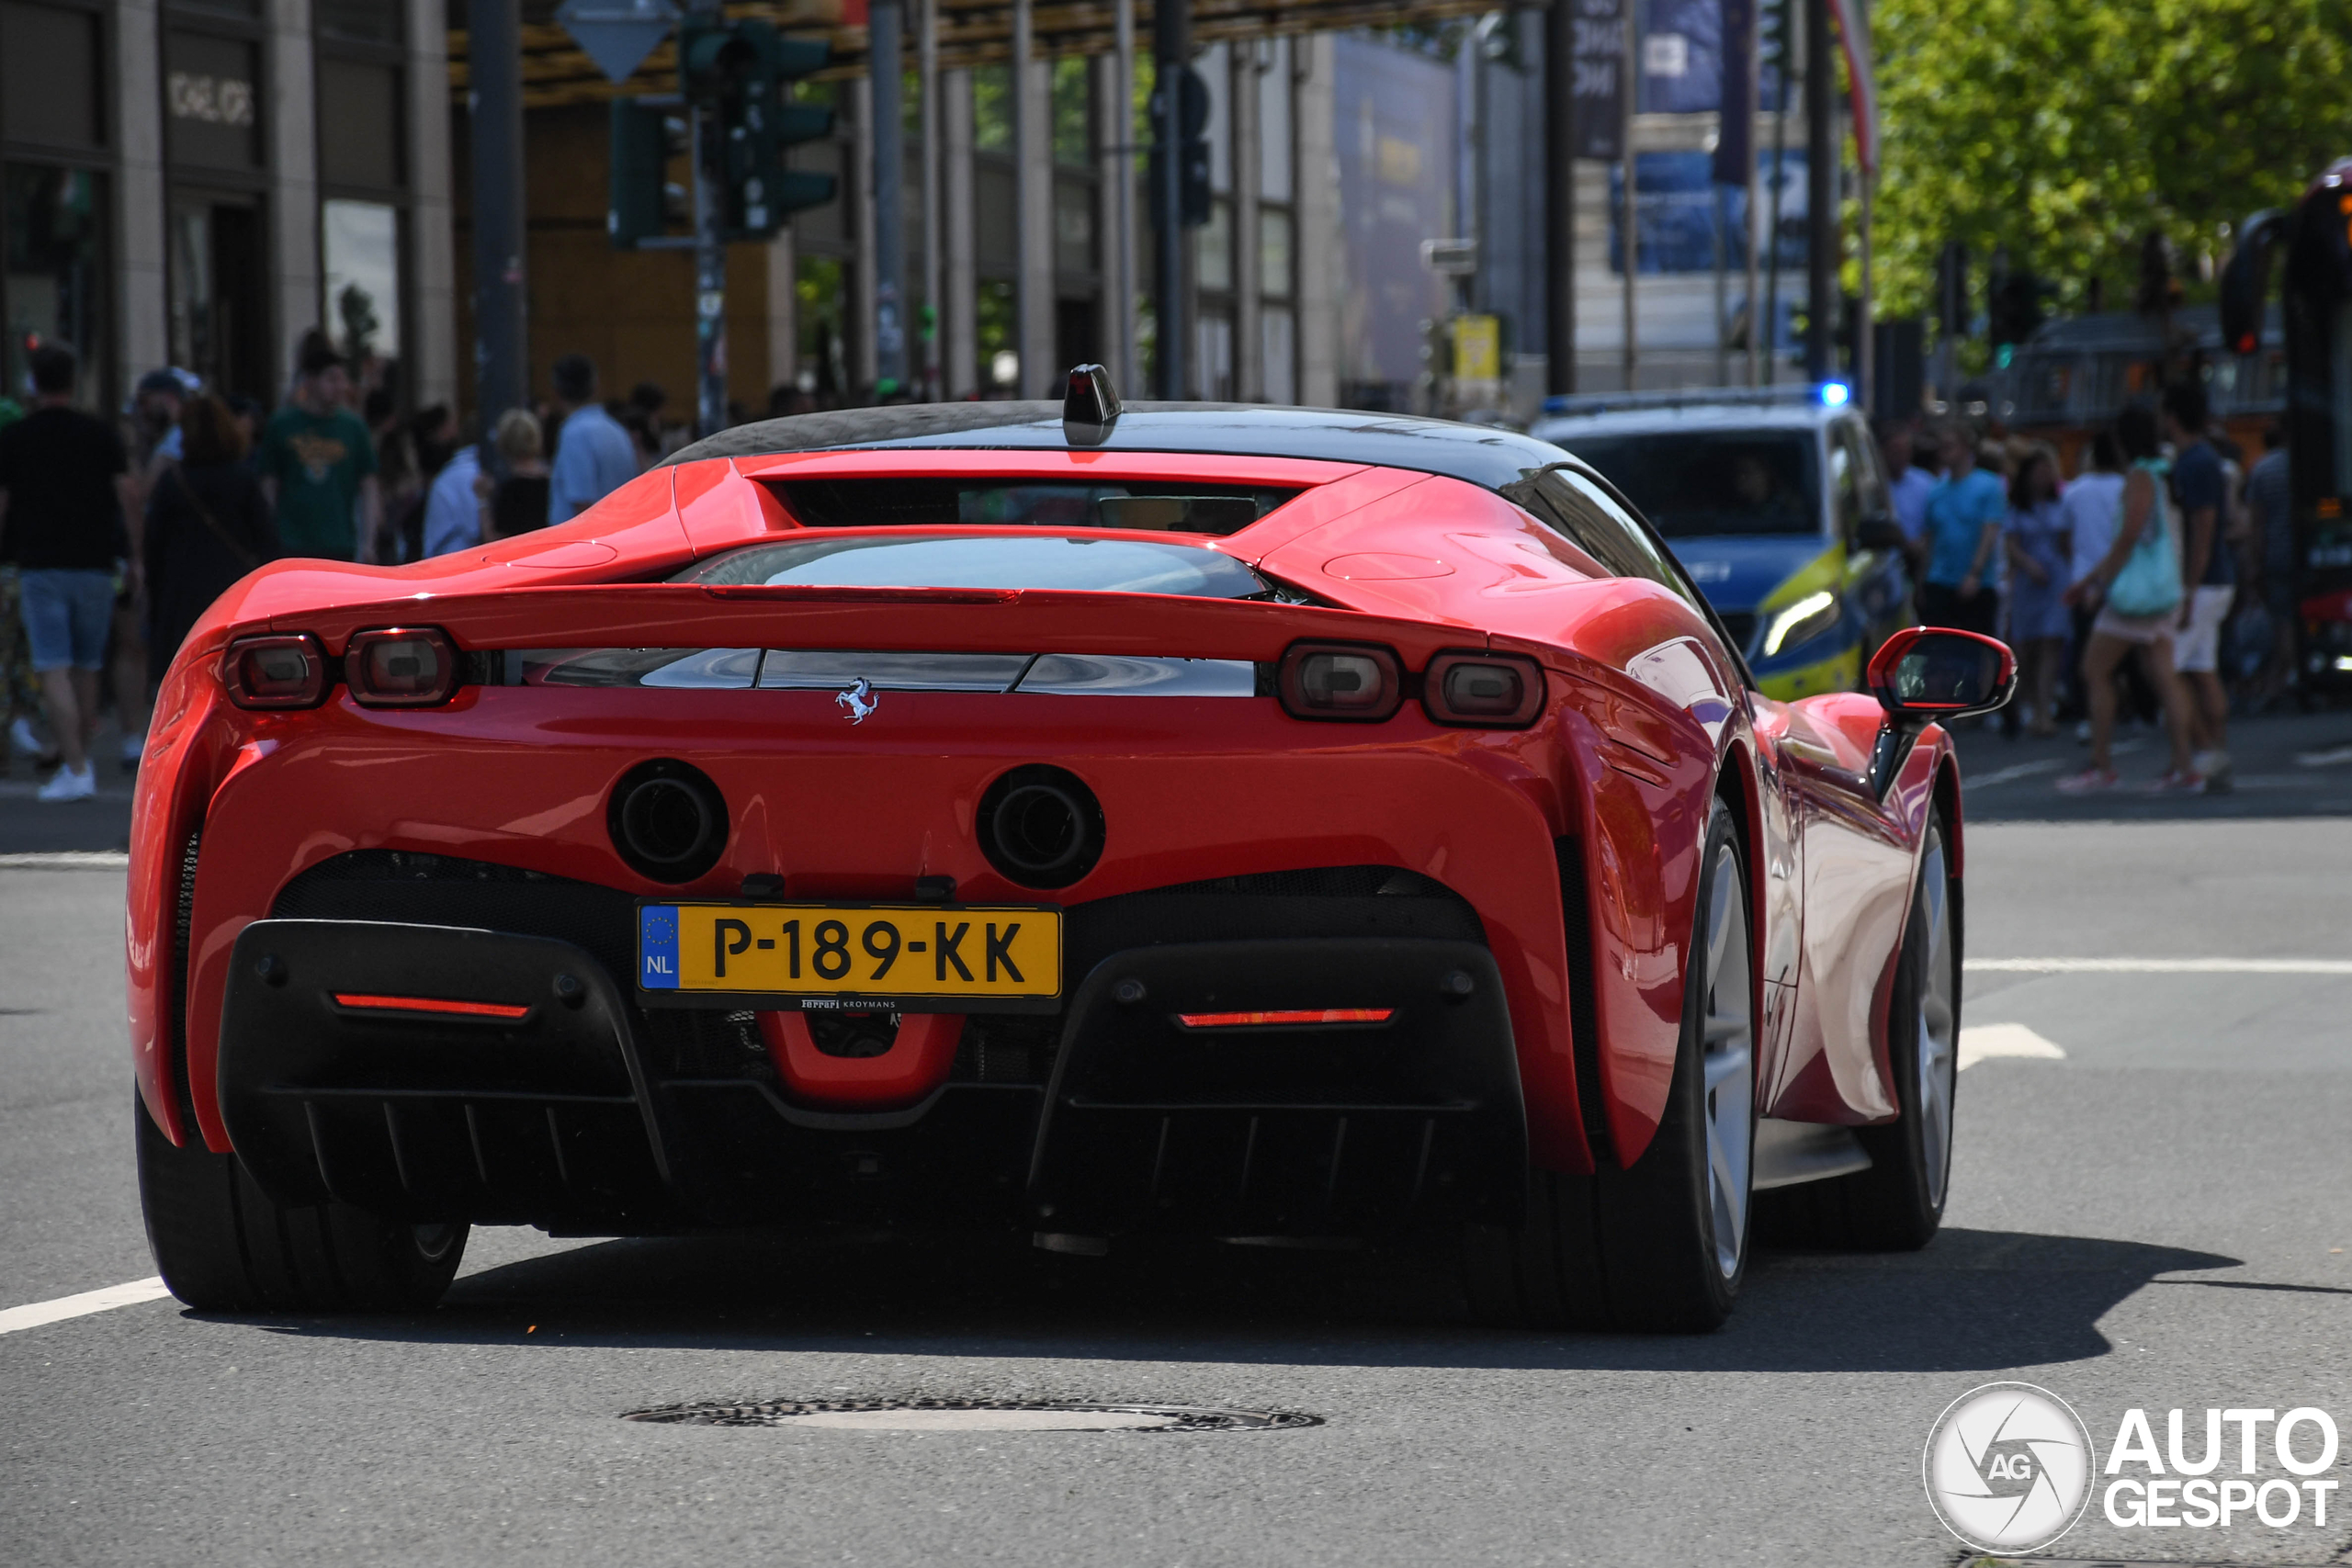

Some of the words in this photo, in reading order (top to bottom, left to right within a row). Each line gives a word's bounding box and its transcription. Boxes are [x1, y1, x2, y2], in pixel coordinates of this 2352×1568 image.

[714, 918, 1025, 983] P-189-KK
[647, 956, 673, 974] NL
[801, 999, 840, 1010] Ferrari
